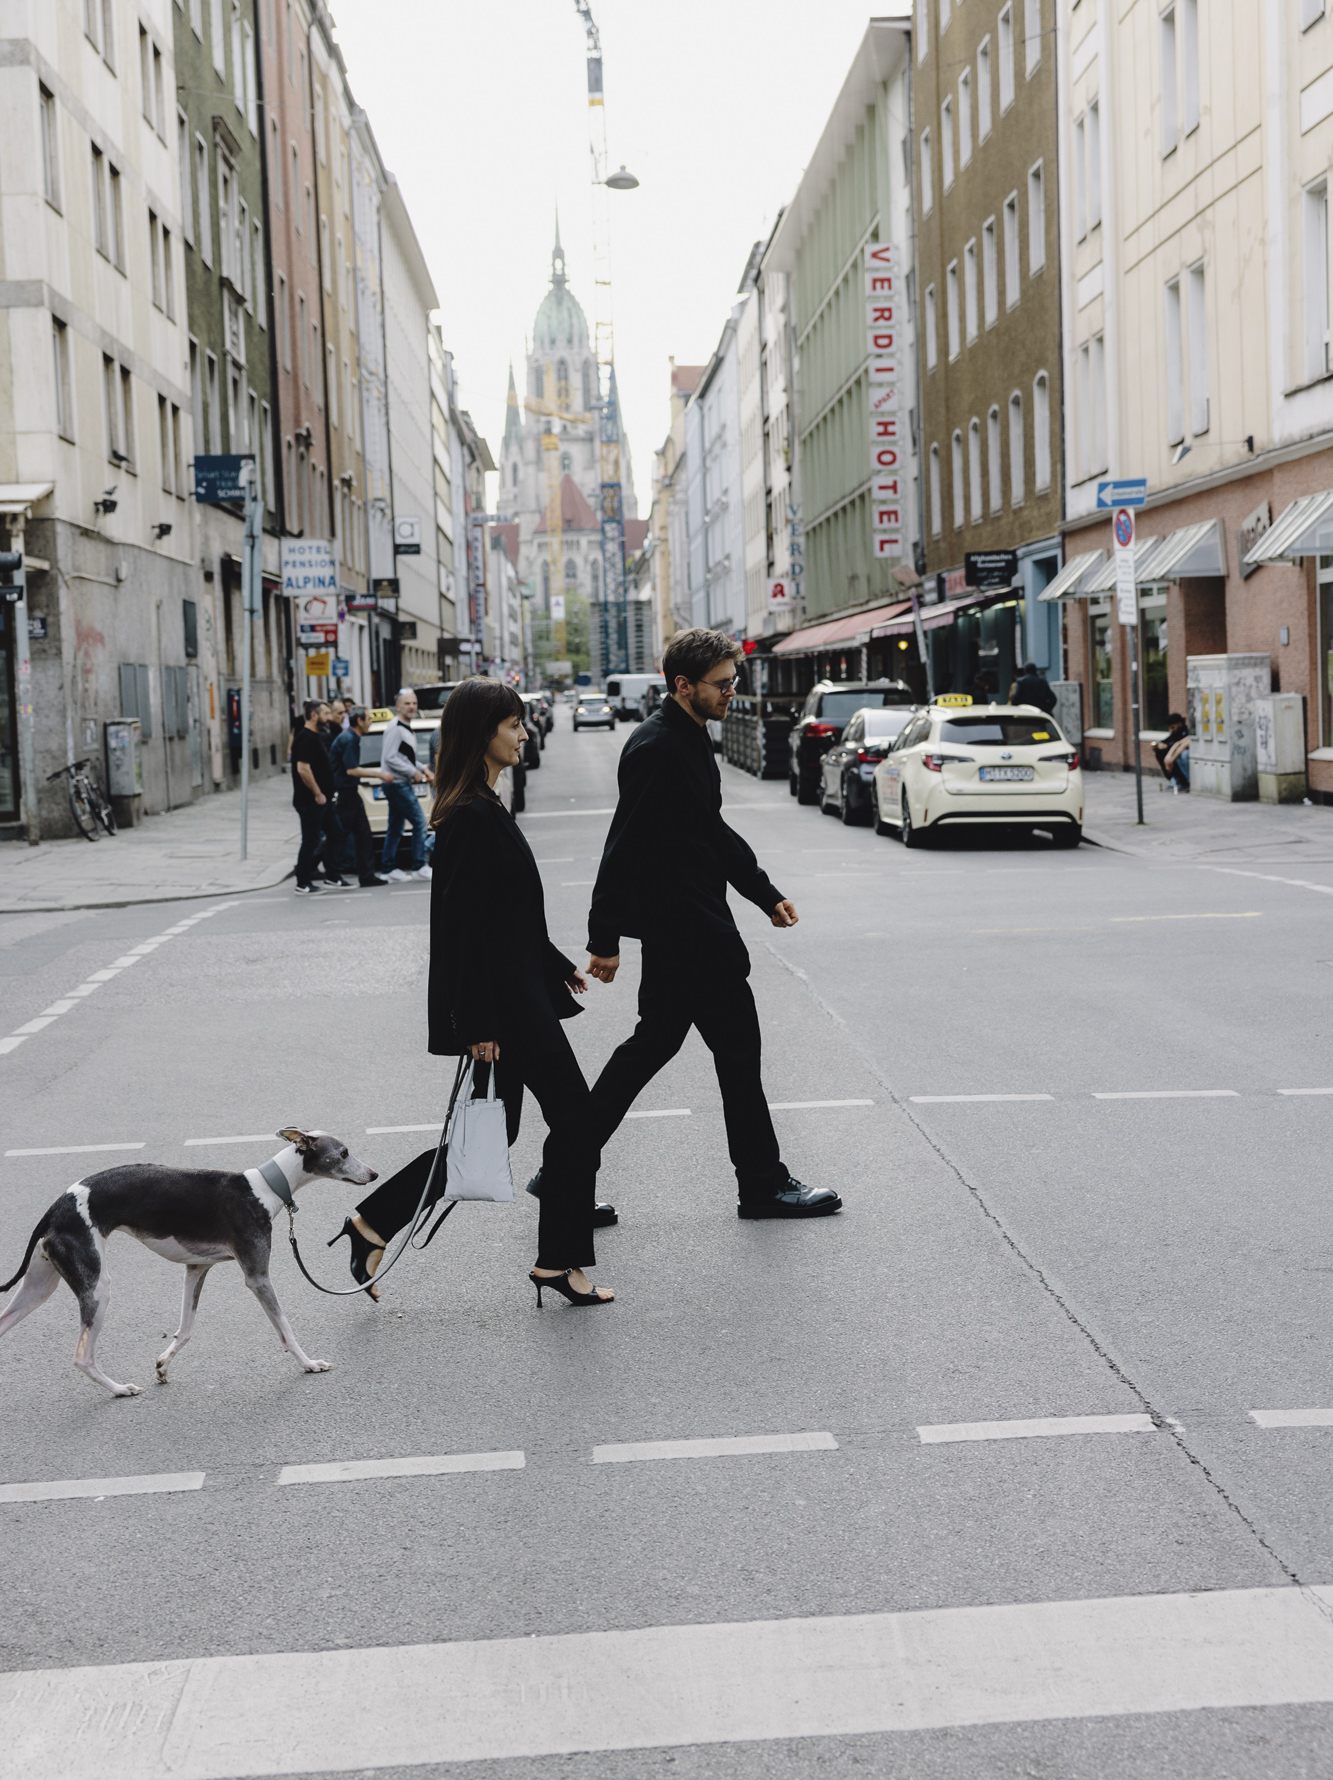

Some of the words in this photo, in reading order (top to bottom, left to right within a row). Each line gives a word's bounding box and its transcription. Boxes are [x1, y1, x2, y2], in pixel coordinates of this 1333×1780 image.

[870, 246, 895, 373] VERDI
[875, 420, 899, 553] HOTEL
[283, 559, 336, 569] PENSION
[288, 545, 331, 555] HOTEL
[788, 504, 804, 596] VERDI
[285, 575, 337, 589] ALPINA
